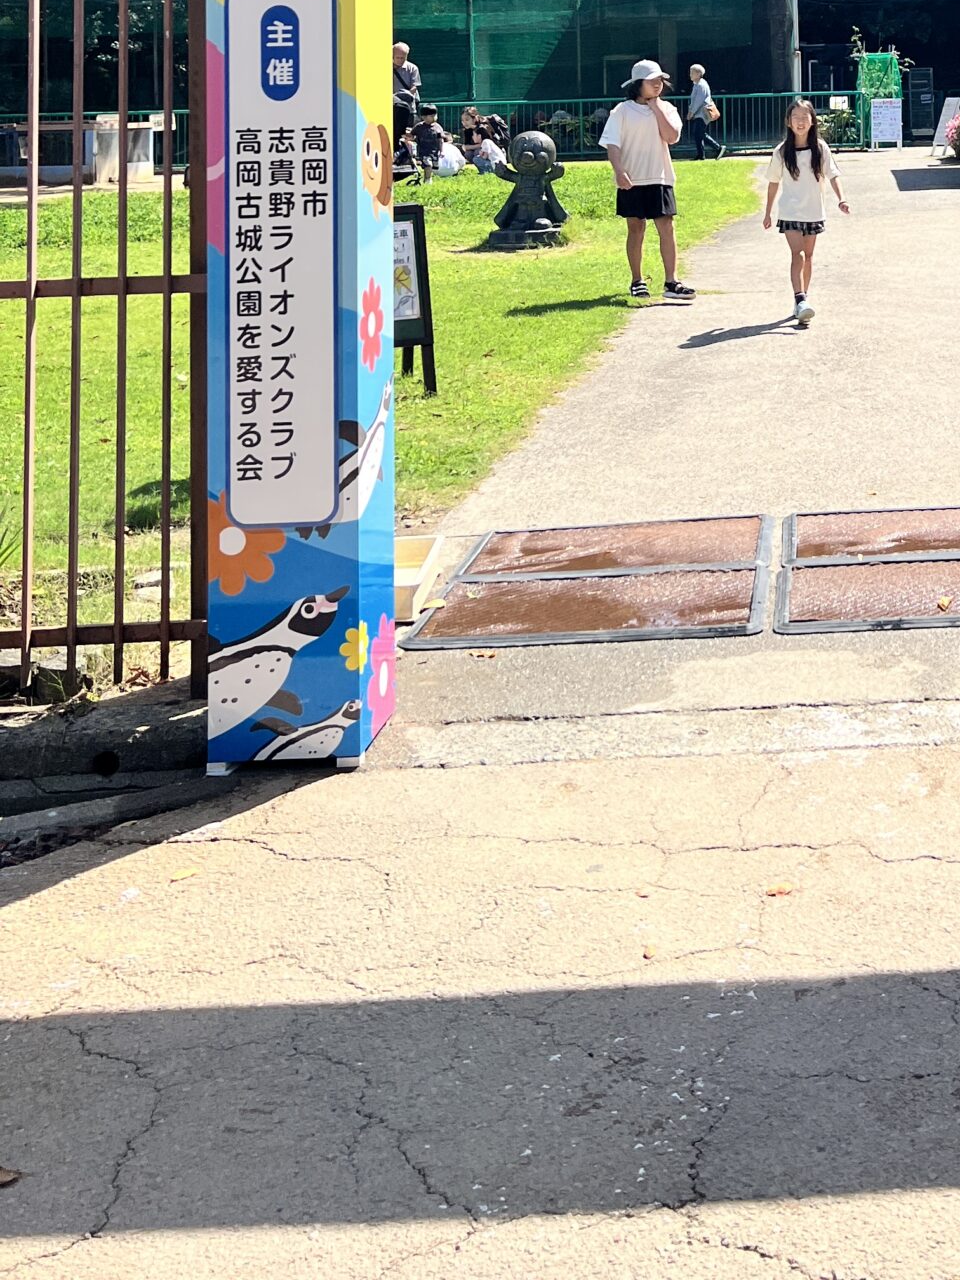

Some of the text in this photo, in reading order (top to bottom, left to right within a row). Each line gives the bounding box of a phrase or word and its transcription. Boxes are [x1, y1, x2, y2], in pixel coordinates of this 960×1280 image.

[266, 20, 294, 87] 主催
[301, 125, 328, 218] 高岡市
[235, 127, 263, 483] 高岡古城公園を愛する会
[268, 126, 297, 481] 志貴野ライオンズクラブ
